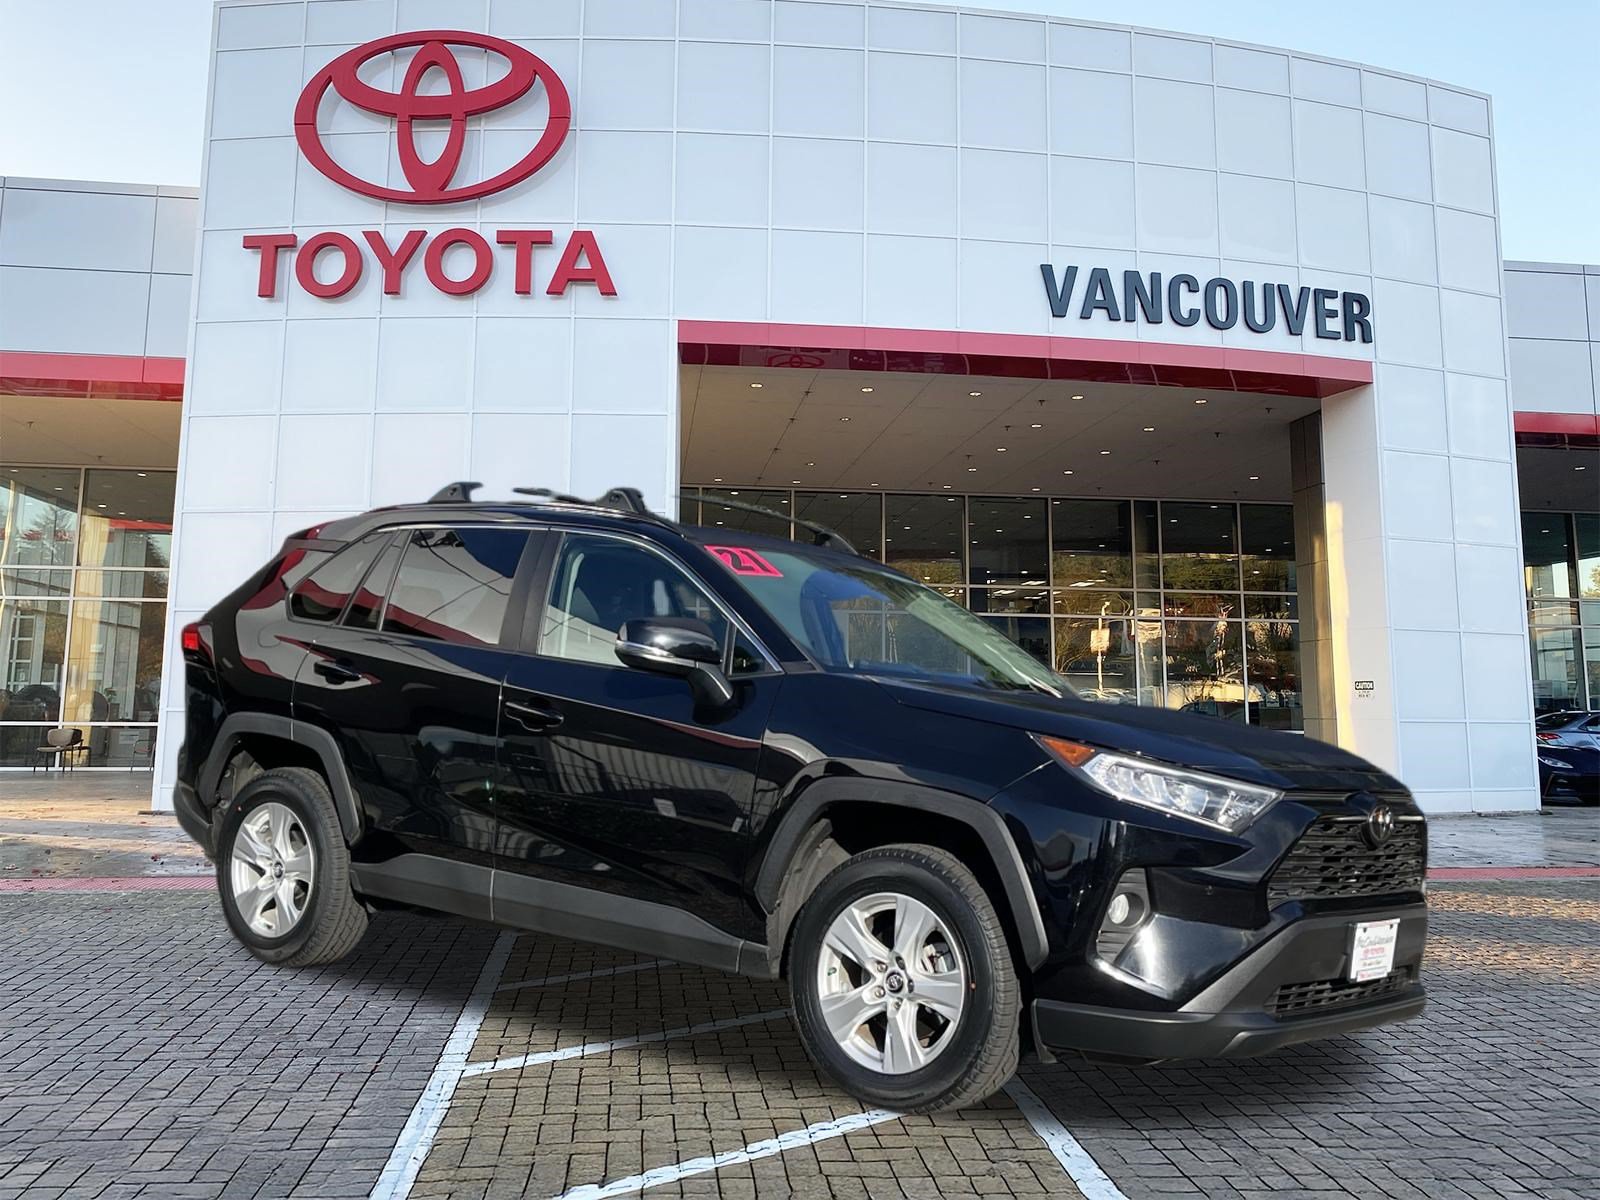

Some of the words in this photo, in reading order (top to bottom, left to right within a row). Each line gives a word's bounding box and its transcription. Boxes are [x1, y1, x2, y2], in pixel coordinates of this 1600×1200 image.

[242, 227, 618, 299] TOYOTA
[1040, 263, 1373, 343] VANCOUVER
[712, 547, 772, 574] 21
